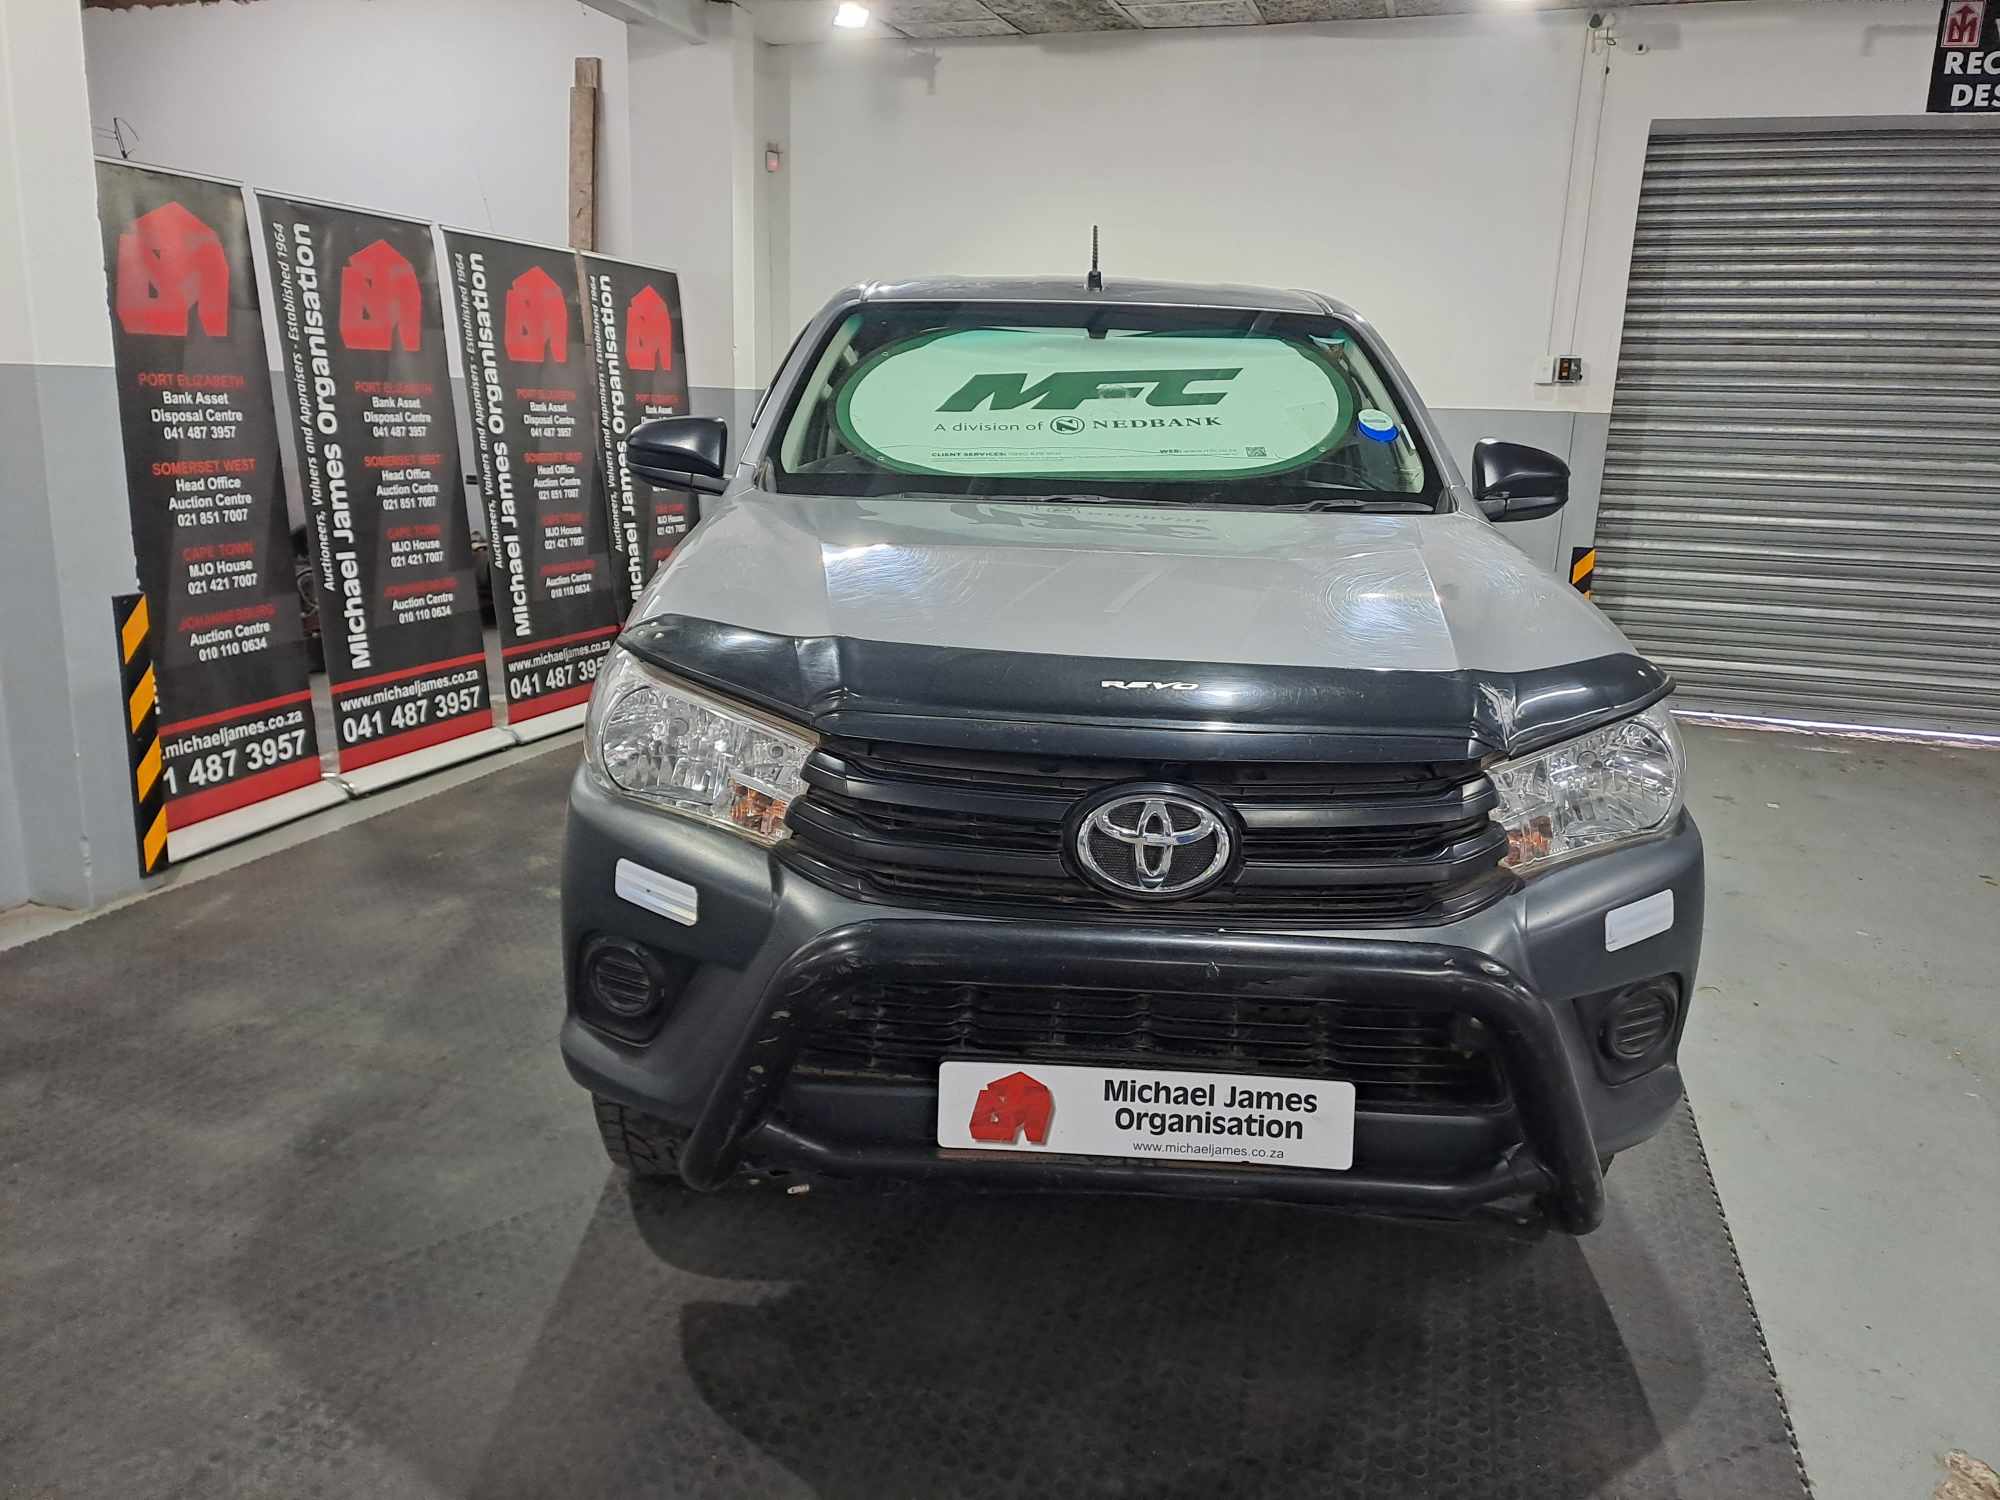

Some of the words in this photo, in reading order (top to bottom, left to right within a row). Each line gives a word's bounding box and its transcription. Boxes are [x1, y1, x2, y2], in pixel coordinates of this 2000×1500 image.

[272, 222, 289, 259] 1964
[276, 261, 300, 342] Established
[293, 223, 338, 435] Organisation
[469, 252, 505, 435] Organisation
[599, 275, 626, 434] Organisation
[137, 372, 173, 387] PORT
[292, 352, 312, 427] Appraisers
[162, 390, 193, 405] Bank
[195, 391, 228, 405] Asset
[151, 408, 203, 424] Disposal
[206, 409, 242, 422] Centre
[363, 411, 403, 424] Disposal
[934, 423, 946, 432] A
[952, 422, 1020, 432] division
[1026, 421, 1044, 431] of
[1092, 417, 1223, 429] NEDBANK
[164, 427, 184, 440] 041
[187, 426, 207, 439] 487
[211, 425, 236, 438] 3957
[303, 426, 316, 454] and
[152, 459, 219, 476] SOMERSET
[224, 458, 256, 474] WEST
[381, 470, 404, 481] Head
[617, 440, 636, 516] James
[175, 478, 204, 492] Head
[208, 476, 241, 490] Office
[308, 456, 323, 506] Valuers
[323, 443, 355, 544] James
[376, 485, 410, 496] Auction
[411, 483, 439, 494] Centre
[493, 441, 518, 528] James
[168, 495, 213, 511] Auction
[215, 493, 252, 507] Centre
[382, 499, 398, 511] 021
[177, 513, 197, 527] 021
[200, 511, 220, 525] 851
[223, 508, 248, 523] 7007
[391, 541, 410, 553] MJO
[412, 540, 440, 551] House
[189, 562, 214, 577] MJO
[217, 559, 253, 574] House
[391, 556, 406, 568] 021
[407, 553, 423, 566] 421
[188, 579, 207, 595] 021
[210, 577, 230, 591] 421
[232, 573, 258, 588] 7007
[502, 534, 531, 637] Michael
[335, 551, 372, 670] Michael
[392, 596, 425, 611] Auction
[426, 592, 454, 605] Centre
[190, 627, 233, 647] Auction
[235, 621, 271, 638] Centre
[199, 646, 218, 662] 010
[220, 642, 239, 657] 110
[242, 636, 268, 653] 0634
[340, 668, 478, 712] www.michaeljames.co.za
[510, 673, 542, 699] 041
[546, 664, 573, 689] 487
[342, 709, 384, 744] 041
[390, 700, 429, 729] 487
[434, 686, 481, 718] 3957
[188, 748, 238, 786] 487
[245, 728, 306, 770] 3957
[1103, 1079, 1215, 1107] Michael
[1223, 1086, 1318, 1113] James
[1115, 1107, 1303, 1140] Organisation
[1132, 1142, 1284, 1159] www.michaeljames.co.za
